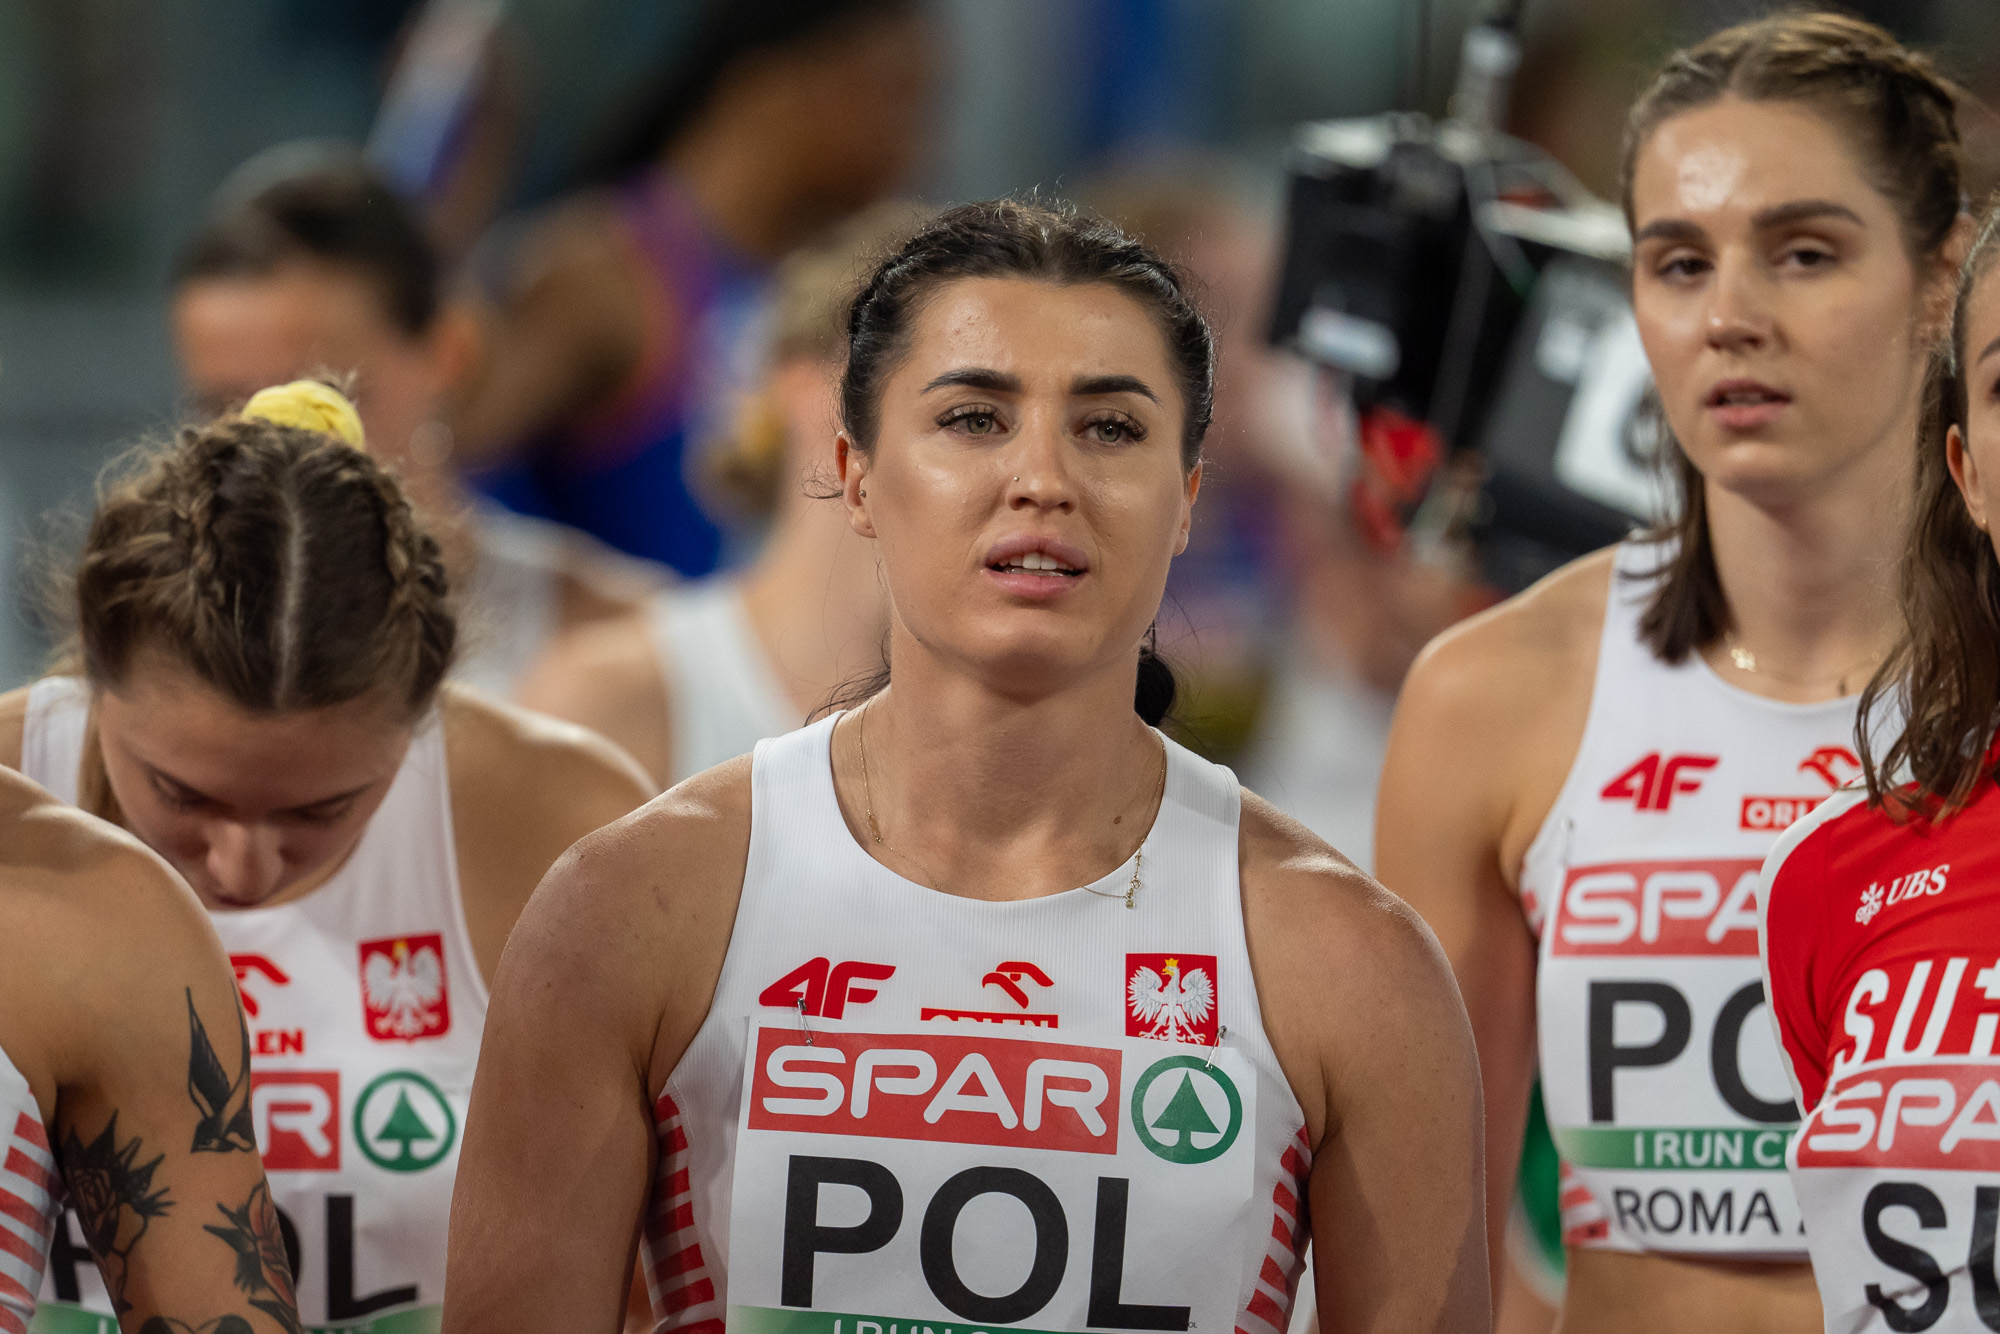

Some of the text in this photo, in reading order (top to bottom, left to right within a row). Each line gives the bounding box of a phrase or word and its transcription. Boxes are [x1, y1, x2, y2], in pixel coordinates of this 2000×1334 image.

[1599, 752, 1720, 812] 4F
[1562, 871, 1759, 944] SPA
[1886, 864, 1950, 906] UBS
[759, 956, 896, 1020] 4F
[762, 1044, 1110, 1137] SPAR
[1653, 1132, 1743, 1167] RUN
[1613, 1188, 1780, 1235] ROMA
[781, 1155, 1191, 1331] POL
